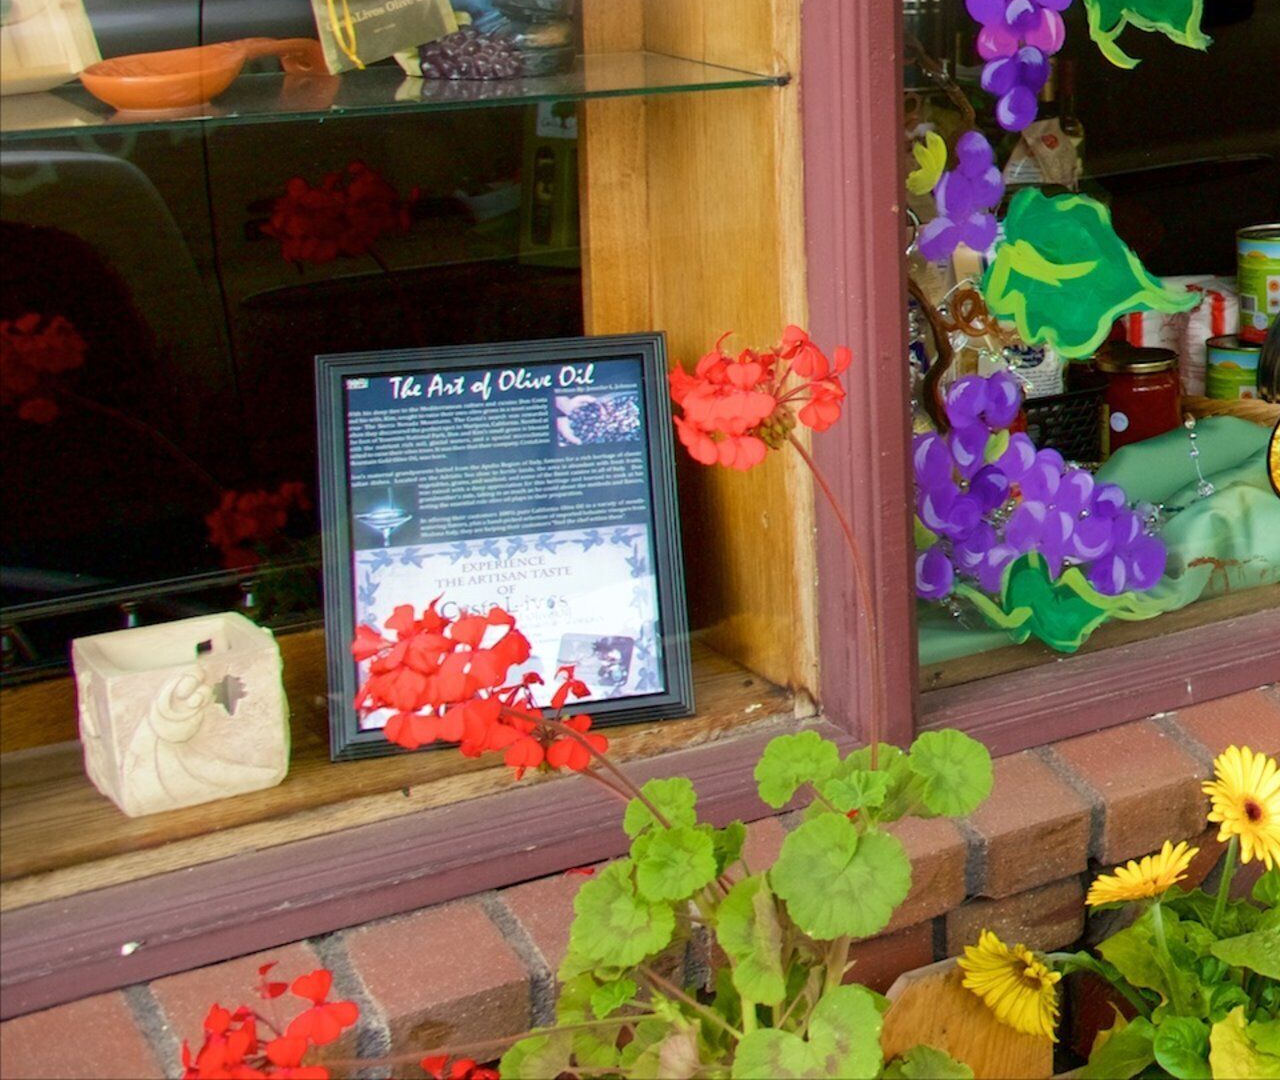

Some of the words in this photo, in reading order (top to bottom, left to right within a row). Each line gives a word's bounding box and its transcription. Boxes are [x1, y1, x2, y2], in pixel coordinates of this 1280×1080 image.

[389, 376, 422, 400] The
[426, 374, 465, 398] Art
[470, 371, 492, 401] of
[498, 368, 553, 392] Olive
[559, 363, 595, 387] Oil
[461, 555, 546, 573] EXPERIENCE
[434, 576, 468, 589] THE
[470, 571, 528, 586] ARTISAN
[528, 565, 573, 579] TASTE
[496, 583, 516, 596] OF
